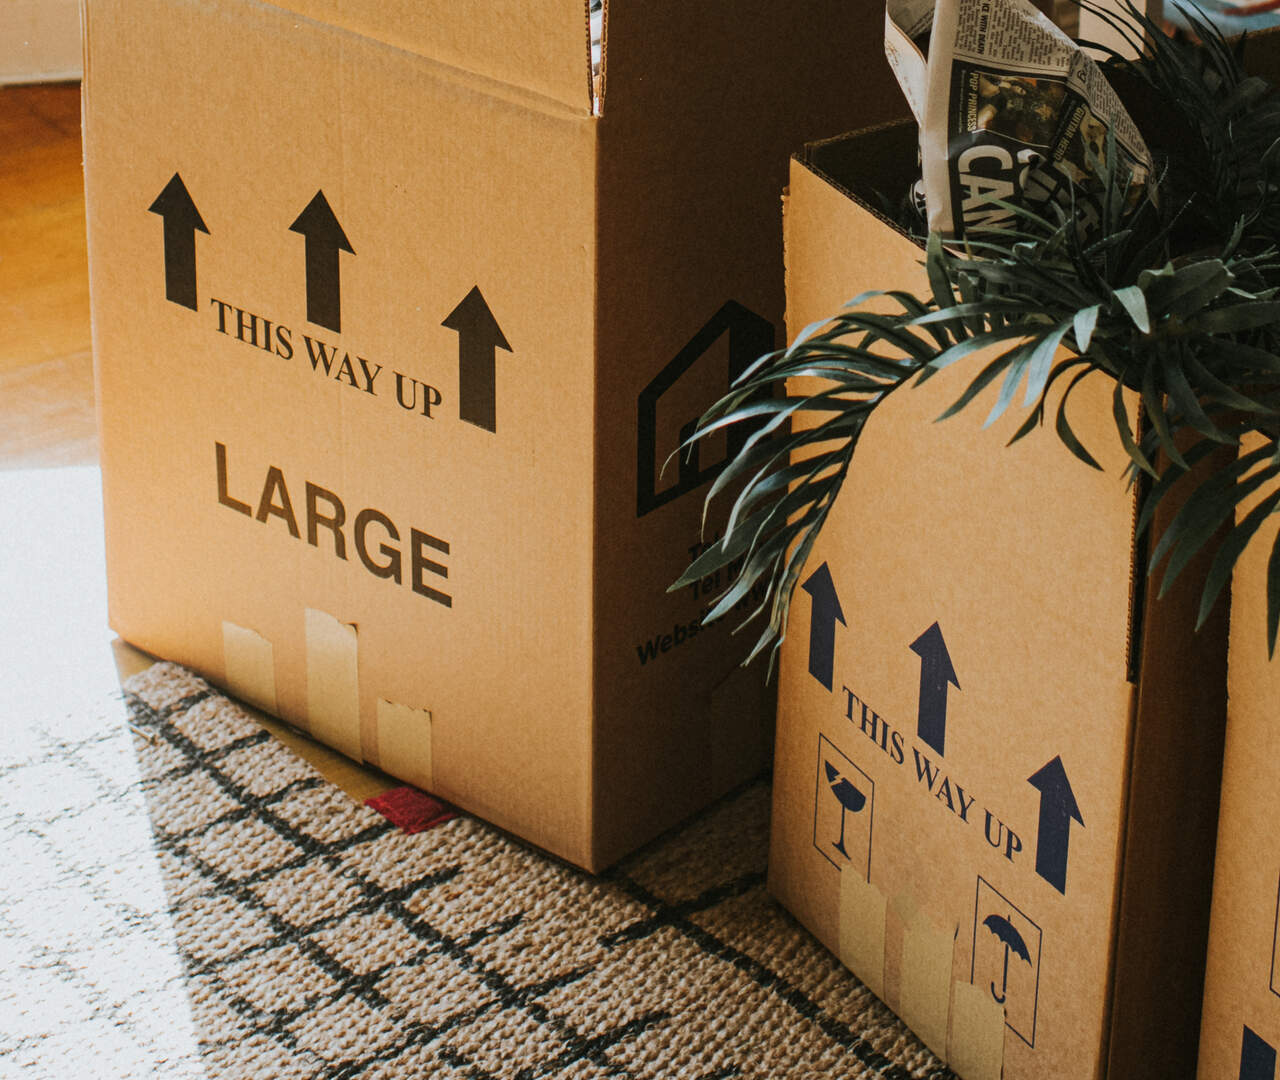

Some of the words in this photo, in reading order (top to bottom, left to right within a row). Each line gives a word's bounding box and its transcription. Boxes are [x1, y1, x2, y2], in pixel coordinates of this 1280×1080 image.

[967, 94, 979, 132] PRINCESS
[968, 71, 980, 91] POP
[1064, 107, 1084, 139] GUITAR
[210, 298, 293, 360] THIS
[302, 334, 384, 396] WAY
[392, 370, 442, 420] UP
[215, 440, 452, 609] LARGE
[842, 685, 904, 765] THIS
[912, 746, 976, 824] WAY
[984, 808, 1022, 863] UP
